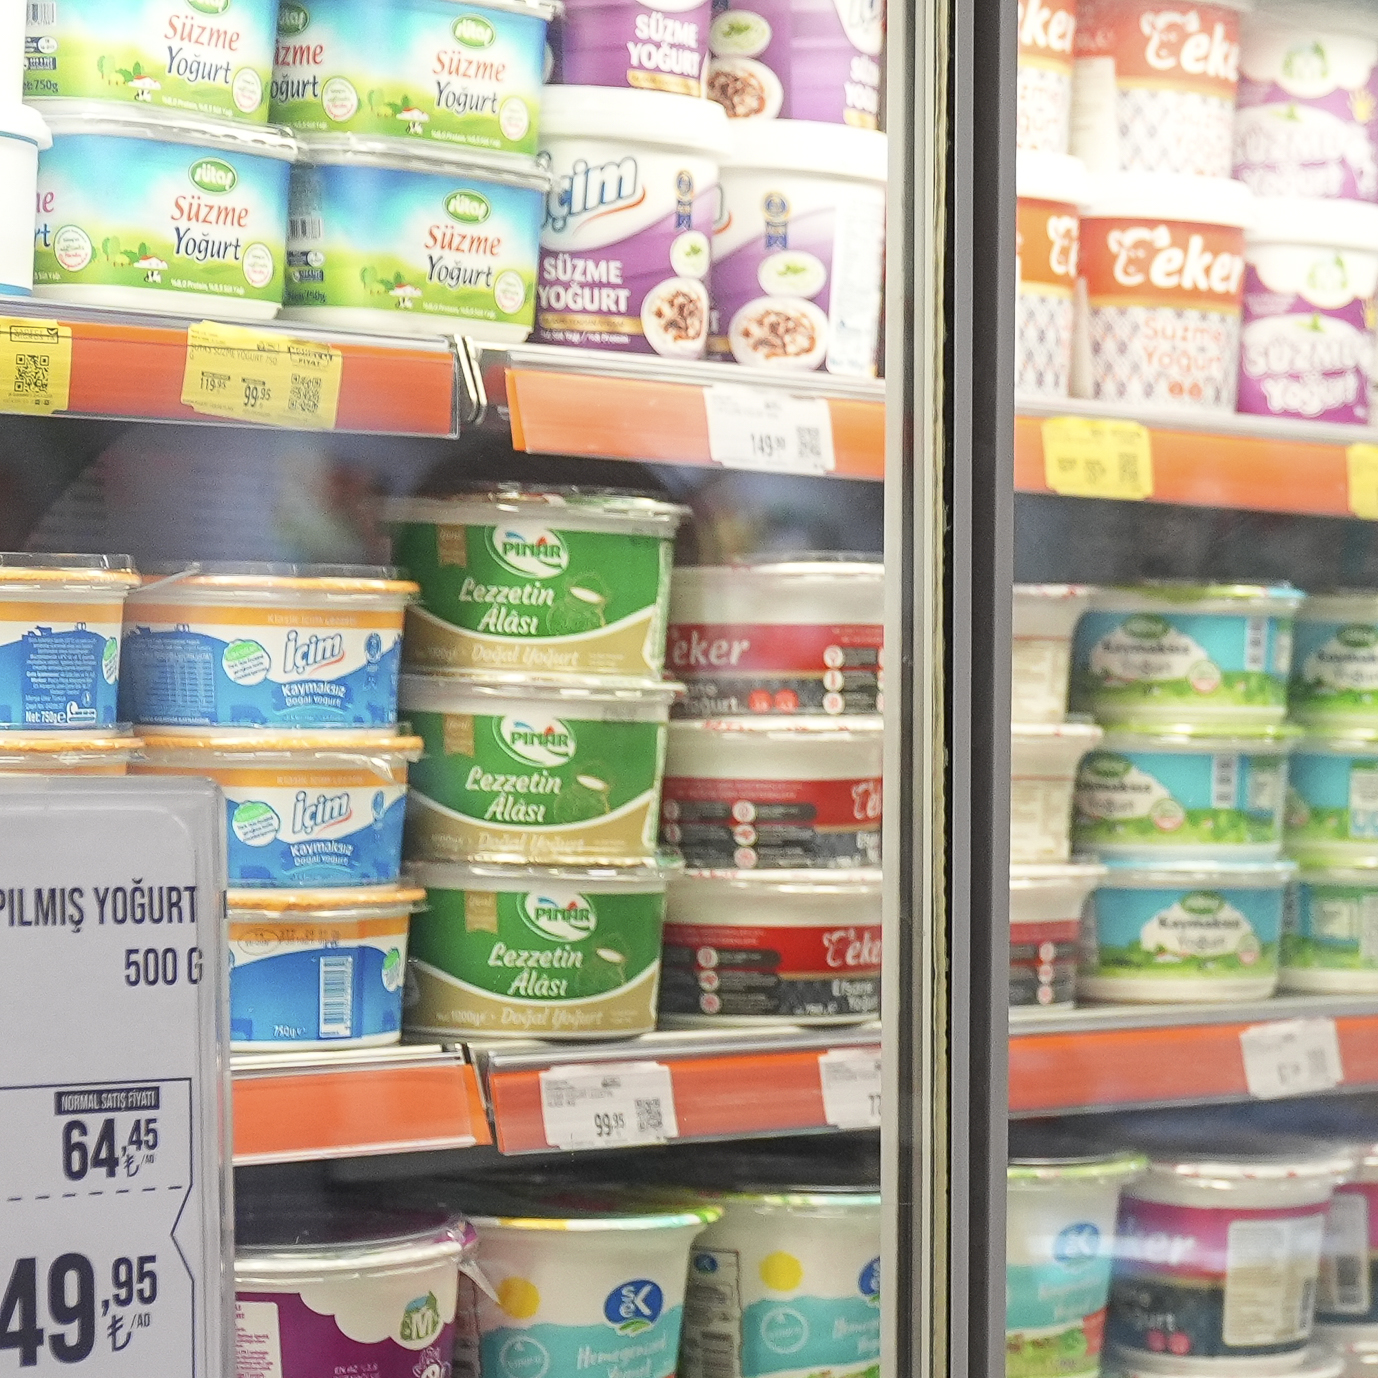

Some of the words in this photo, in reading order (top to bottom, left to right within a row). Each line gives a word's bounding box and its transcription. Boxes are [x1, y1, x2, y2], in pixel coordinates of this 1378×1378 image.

[164, 14, 241, 51] Süzme
[635, 12, 698, 48] SÜZME
[166, 46, 232, 84] Yoğurt
[432, 49, 506, 83] Süzme
[270, 74, 319, 100] oğurt
[434, 81, 498, 115] Yoğurt
[170, 195, 249, 228] Süzme
[546, 157, 638, 233] çim
[173, 227, 241, 265] Yoğurt
[425, 225, 501, 257] Süzme
[426, 255, 494, 290] Yoğurt
[543, 254, 623, 286] SÜZME
[537, 283, 631, 314] YOĞURT
[458, 577, 555, 607] Lezzetin
[283, 630, 343, 675] İçim
[465, 767, 562, 796] Lezzetin
[292, 790, 350, 835] İçim
[93, 878, 198, 927] YOĞURT
[124, 947, 178, 988] 500
[187, 948, 203, 986] G
[487, 942, 583, 970] Lezzetin
[61, 1096, 99, 1113] NORMAL
[100, 1094, 126, 1112] SATIŞ
[127, 1091, 155, 1109] FİYATI
[62, 1117, 159, 1181] 64,45
